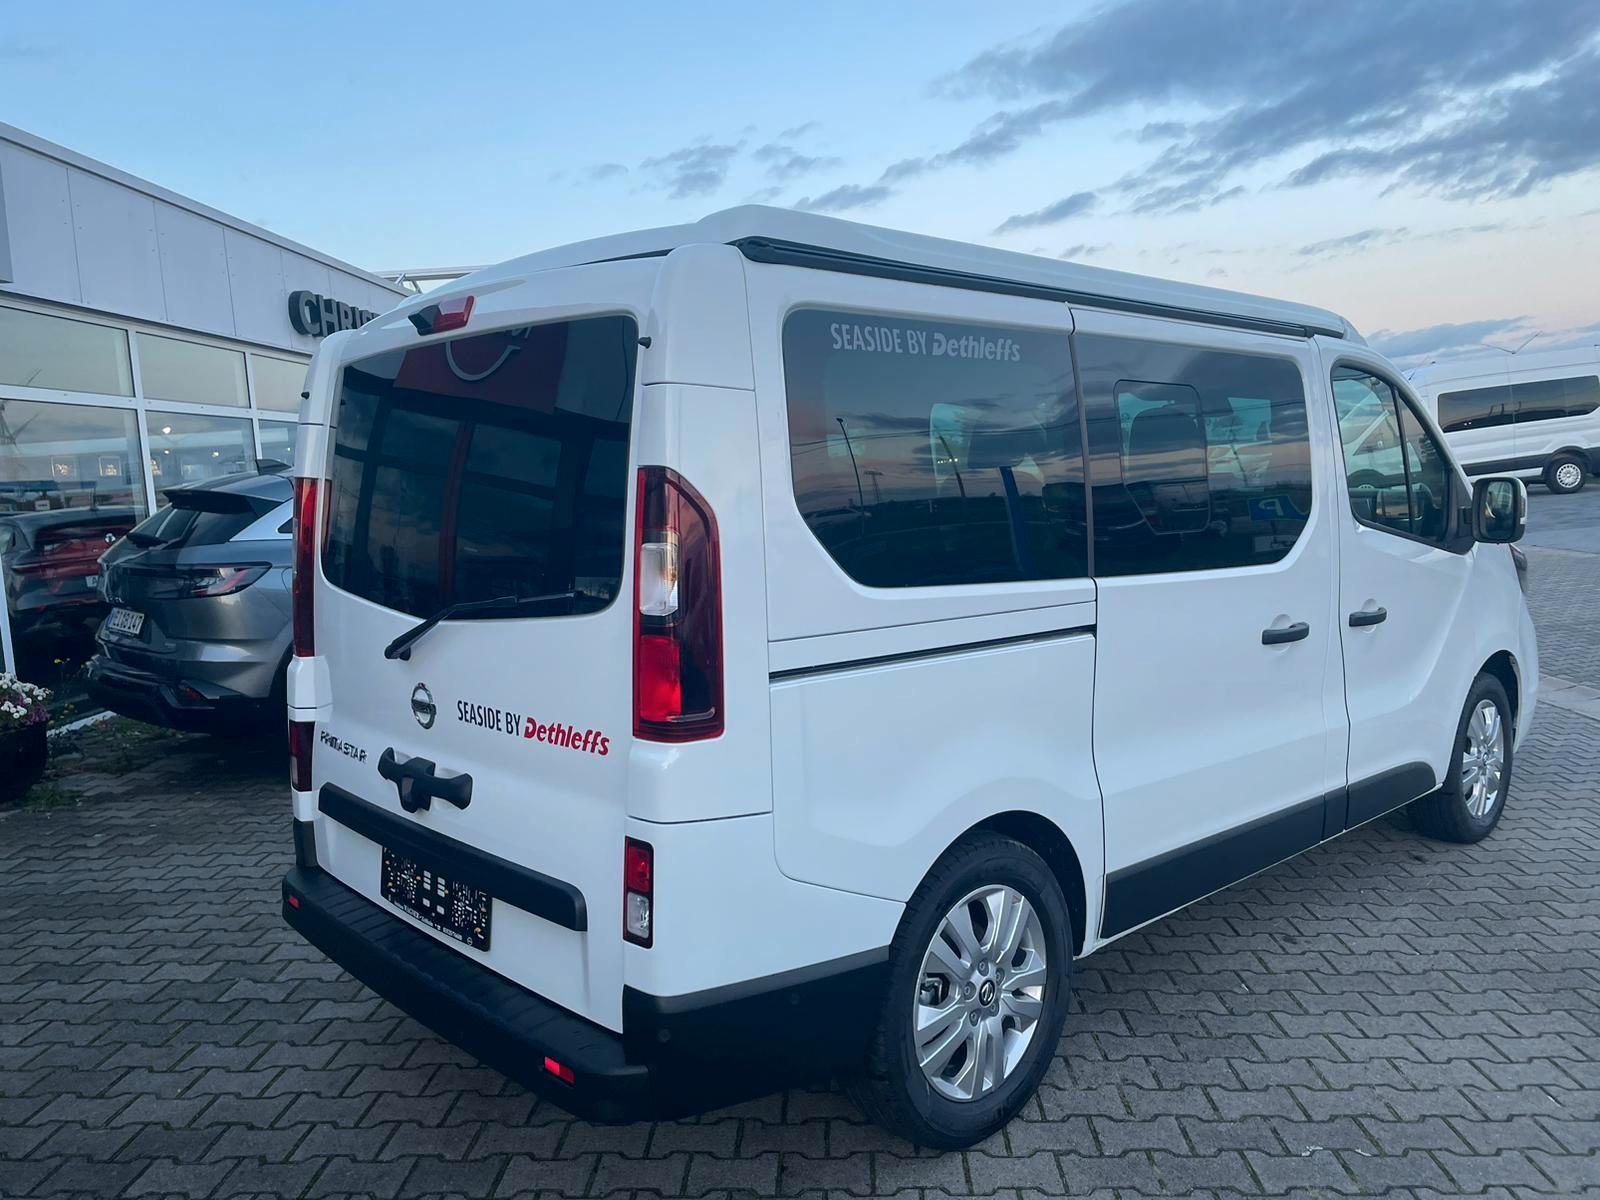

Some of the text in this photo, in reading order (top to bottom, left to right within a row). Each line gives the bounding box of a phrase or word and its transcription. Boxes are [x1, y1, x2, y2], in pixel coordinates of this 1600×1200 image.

[288, 290, 380, 337] CHRI
[831, 323, 1021, 362] SEASIDE BY Dethleffs
[457, 700, 610, 756] SEASIDE BY Dethleffs
